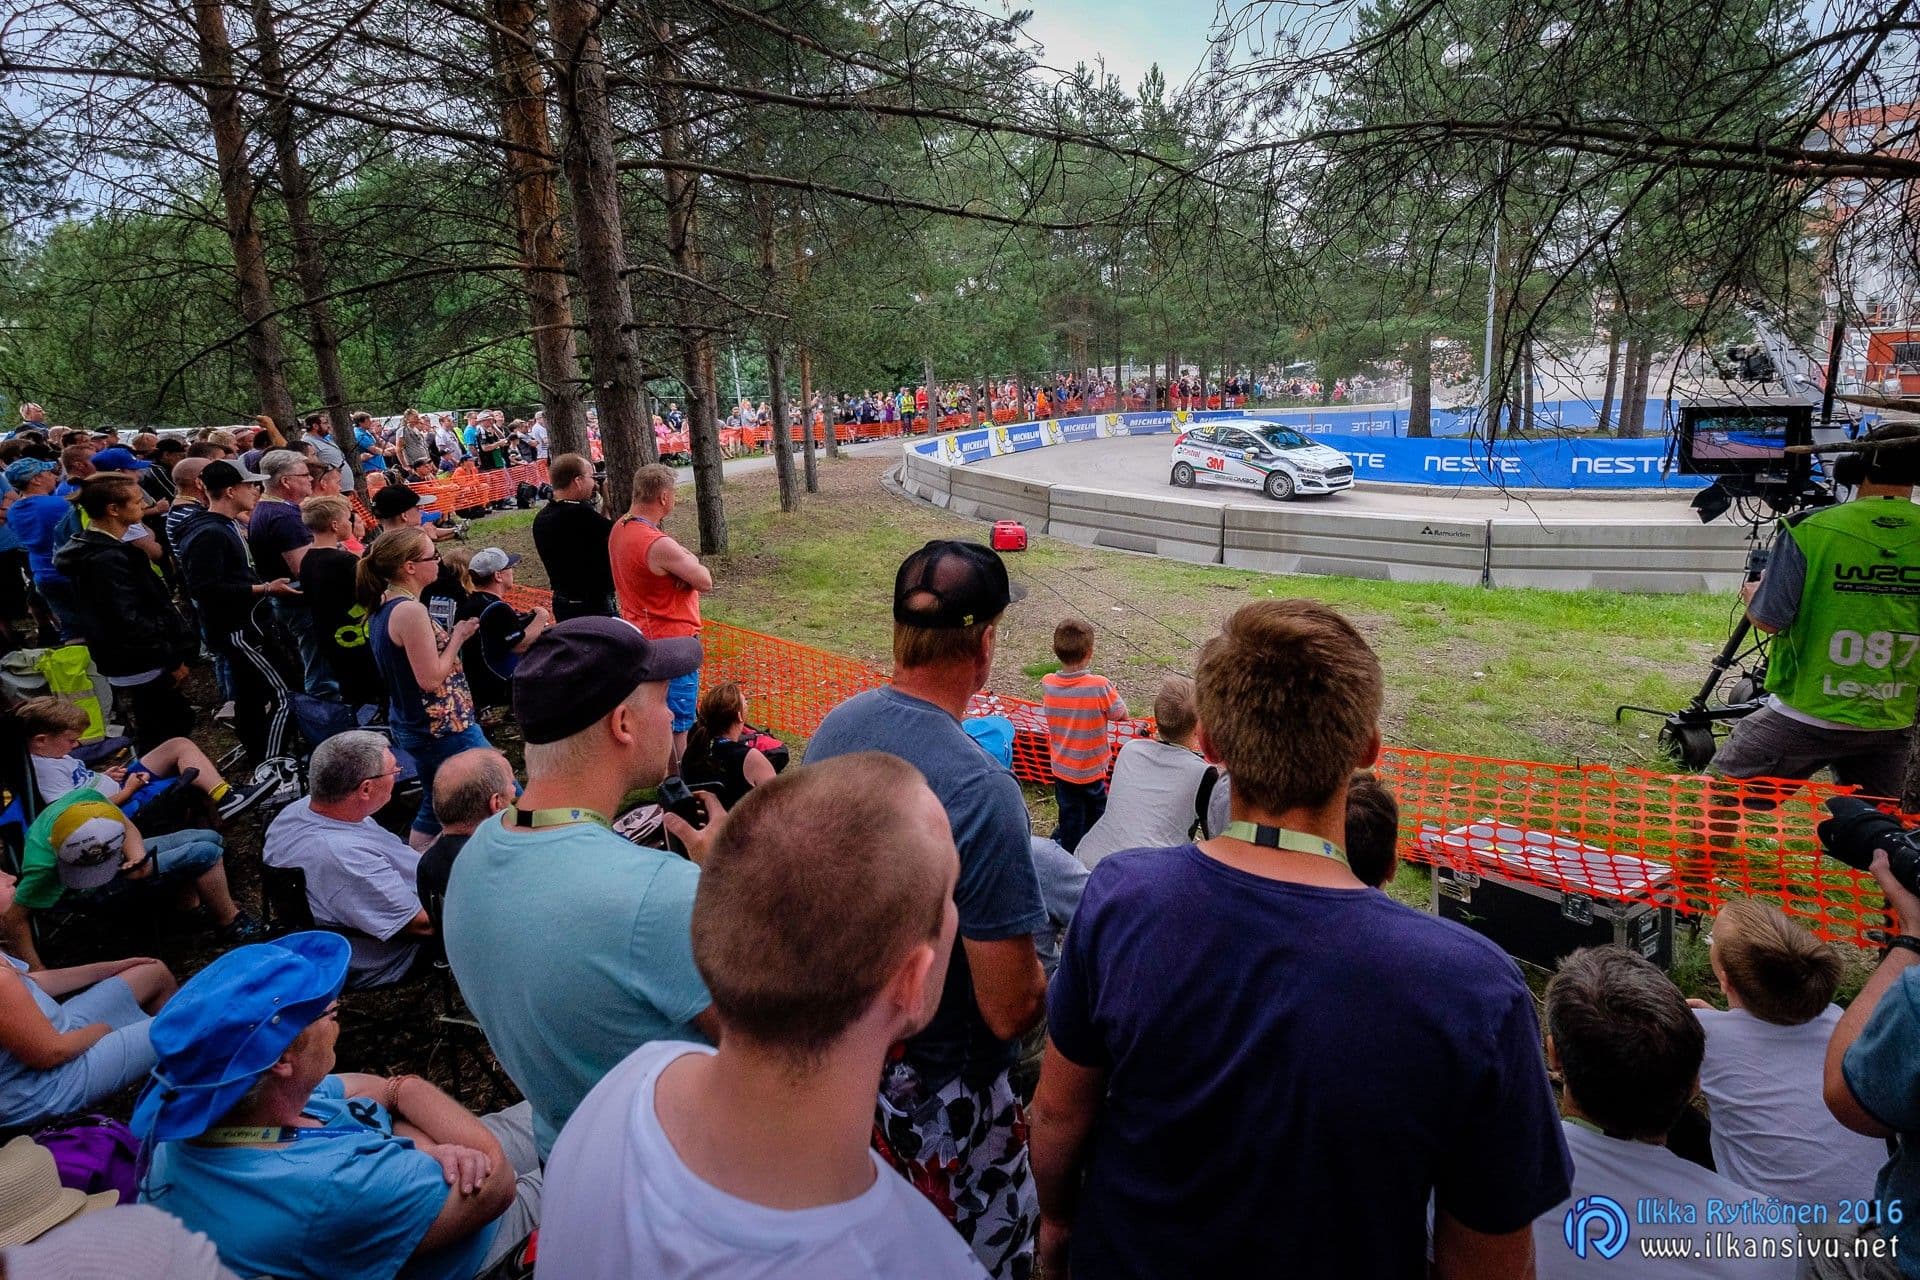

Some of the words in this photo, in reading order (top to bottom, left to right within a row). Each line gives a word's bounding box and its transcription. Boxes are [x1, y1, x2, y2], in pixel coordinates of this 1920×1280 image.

[1063, 423, 1096, 434] MICHELIN
[1129, 416, 1172, 427] MICHELIN
[1013, 430, 1040, 442] MICHELIN
[962, 439, 989, 453] MICHELIN
[1206, 456, 1225, 472] 3M
[1424, 455, 1521, 474] NESTE
[1571, 456, 1679, 474] NESTE
[1829, 629, 1920, 669] 087
[1823, 674, 1910, 701] Lexar
